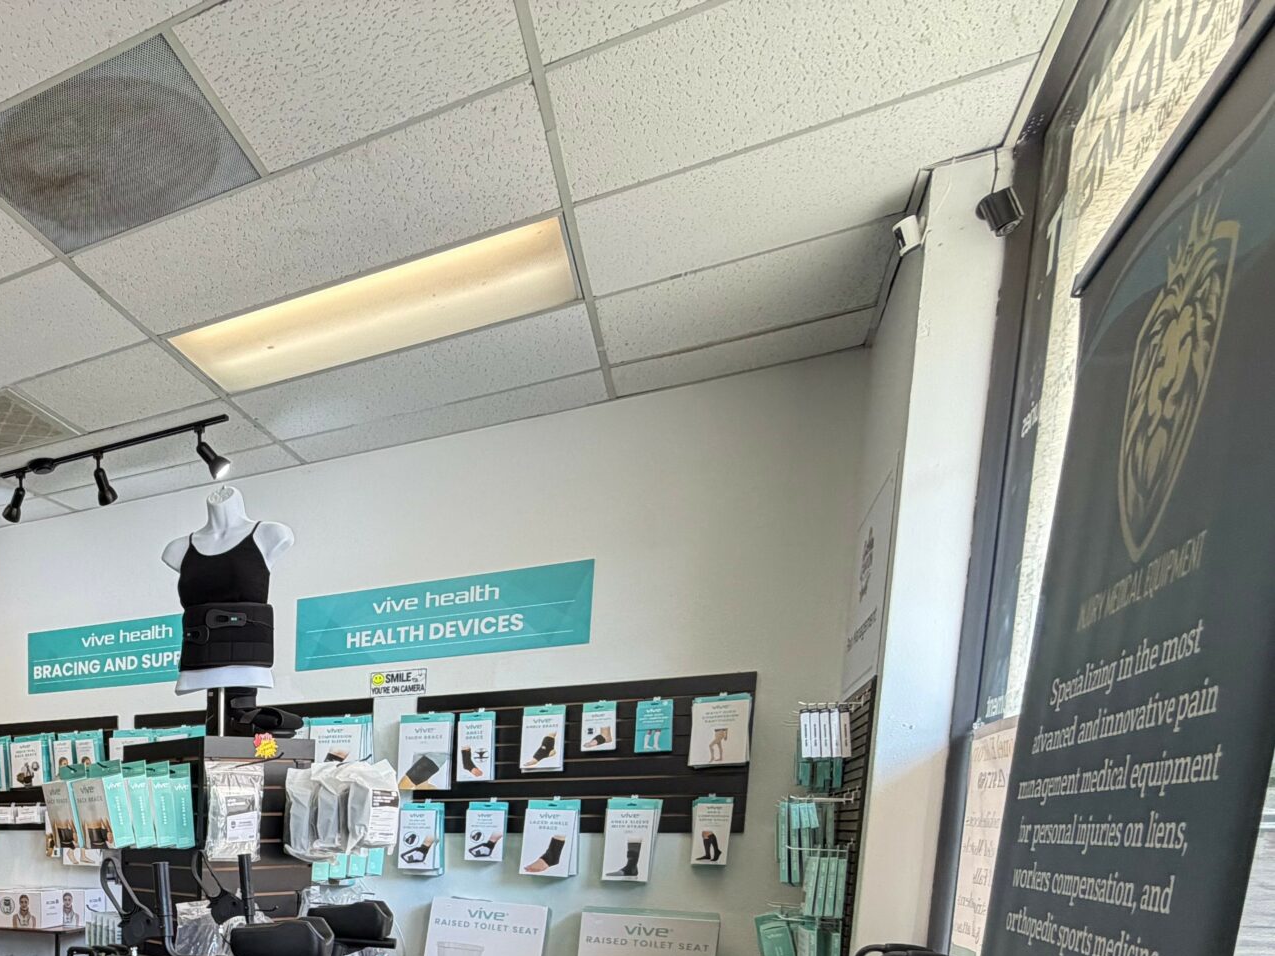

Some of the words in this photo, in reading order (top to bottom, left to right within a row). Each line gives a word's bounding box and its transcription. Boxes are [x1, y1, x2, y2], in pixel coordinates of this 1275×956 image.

[1143, 530, 1208, 599] EQUIPMENT
[372, 597, 419, 615] vive
[425, 584, 500, 609] health
[81, 633, 116, 648] vive
[118, 624, 173, 643] health
[346, 624, 424, 649] HEALTH
[429, 613, 524, 641] DEVICES
[33, 660, 101, 680] BRACING
[104, 655, 138, 673] AND
[385, 671, 412, 684] SMILE
[1050, 659, 1117, 712] Specializing
[1116, 649, 1134, 682] in
[1134, 638, 1159, 676] the
[1159, 619, 1205, 667] most
[371, 686, 391, 695] YOU'RE
[391, 685, 400, 694] ON
[400, 683, 425, 693] CAMERA
[414, 726, 436, 734] vive
[1031, 715, 1078, 755] advanced
[1077, 708, 1102, 745] and
[1099, 692, 1175, 739] innovative
[1173, 677, 1220, 733] pain
[1017, 767, 1081, 806] management
[1080, 754, 1132, 794] medical
[1129, 743, 1223, 799] equipment
[1030, 813, 1078, 851] personal
[1075, 814, 1122, 855] injuries
[1123, 821, 1144, 848] on
[1144, 810, 1189, 857] liens,
[1012, 862, 1052, 893] workers
[1051, 871, 1138, 916] compensation,
[1139, 874, 1176, 915] and
[433, 918, 471, 929] RAISED
[473, 922, 510, 932] TOILET
[512, 926, 540, 936] SEAT
[467, 907, 506, 922] vive
[1005, 906, 1058, 946] orthopedic
[585, 935, 629, 947] RAISED
[633, 939, 675, 950] TOILET
[678, 943, 710, 953] SEAT
[624, 923, 672, 939] vive
